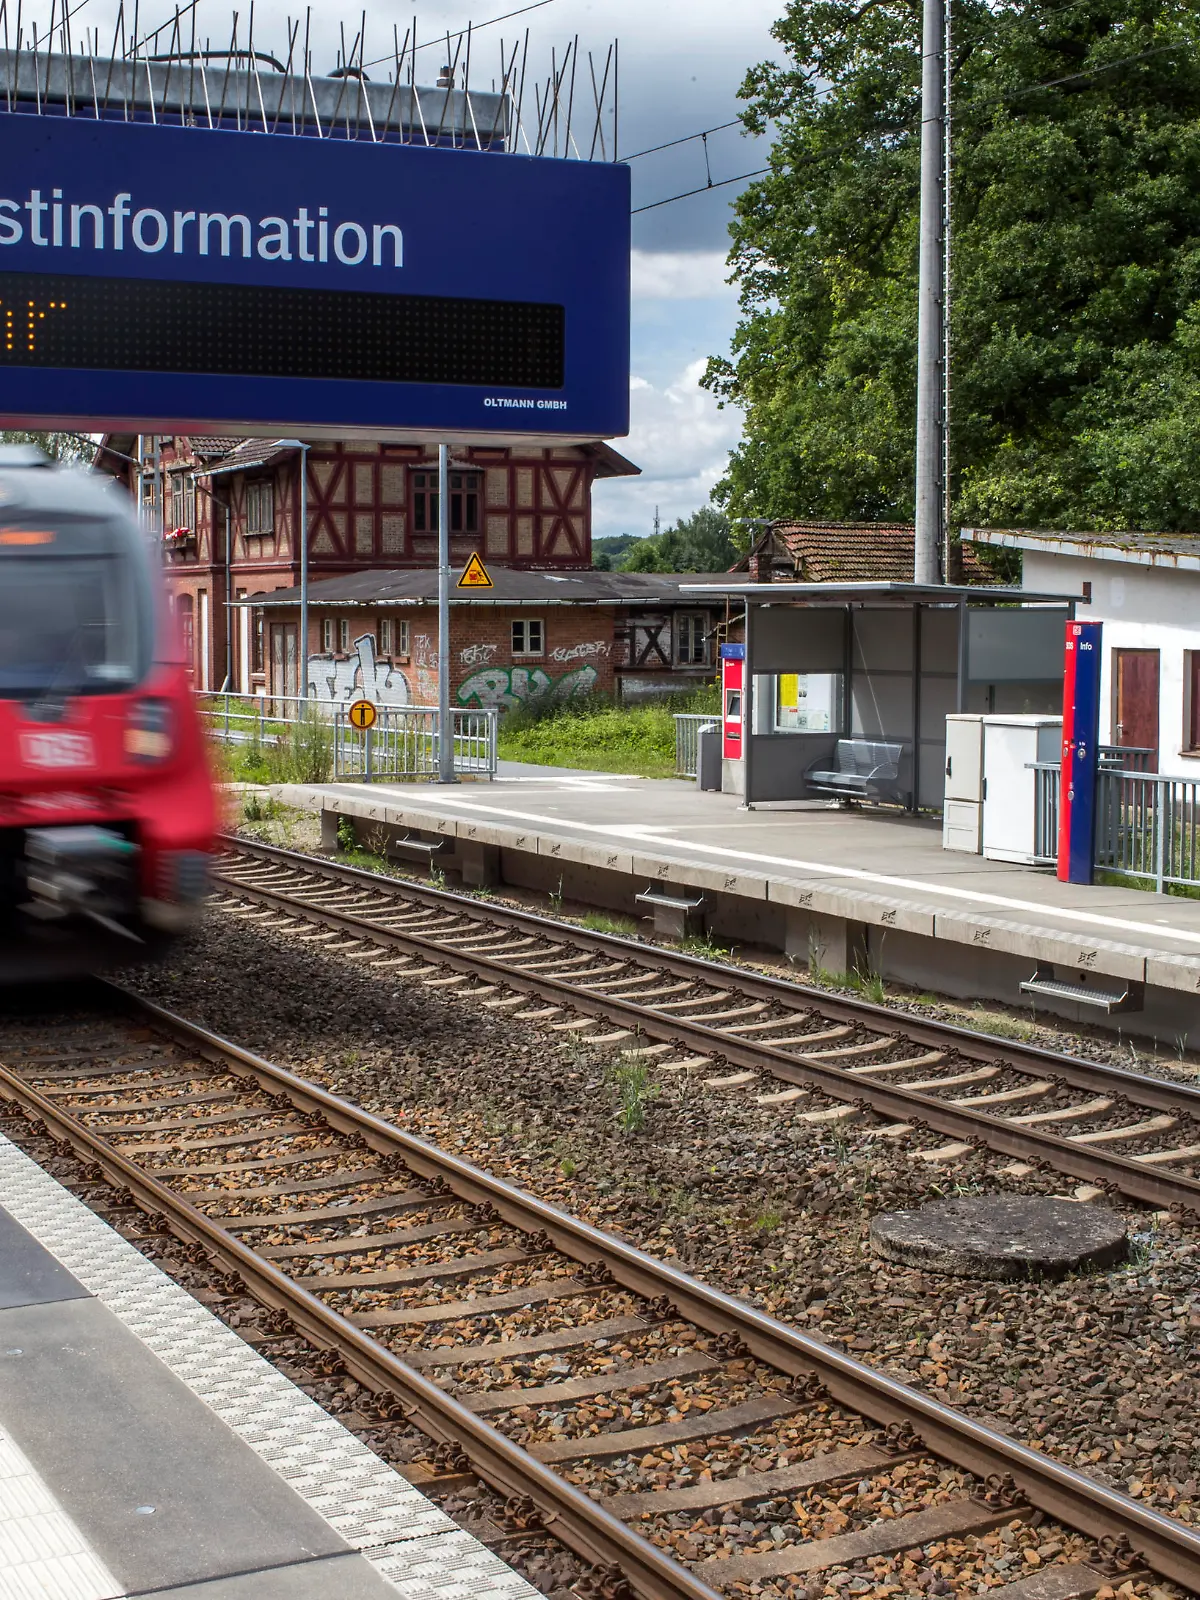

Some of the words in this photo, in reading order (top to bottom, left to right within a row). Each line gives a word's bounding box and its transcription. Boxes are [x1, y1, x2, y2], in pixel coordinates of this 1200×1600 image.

[484, 398, 534, 408] OLTMANN
[537, 400, 567, 410] GMBH
[1080, 641, 1092, 651] Info
